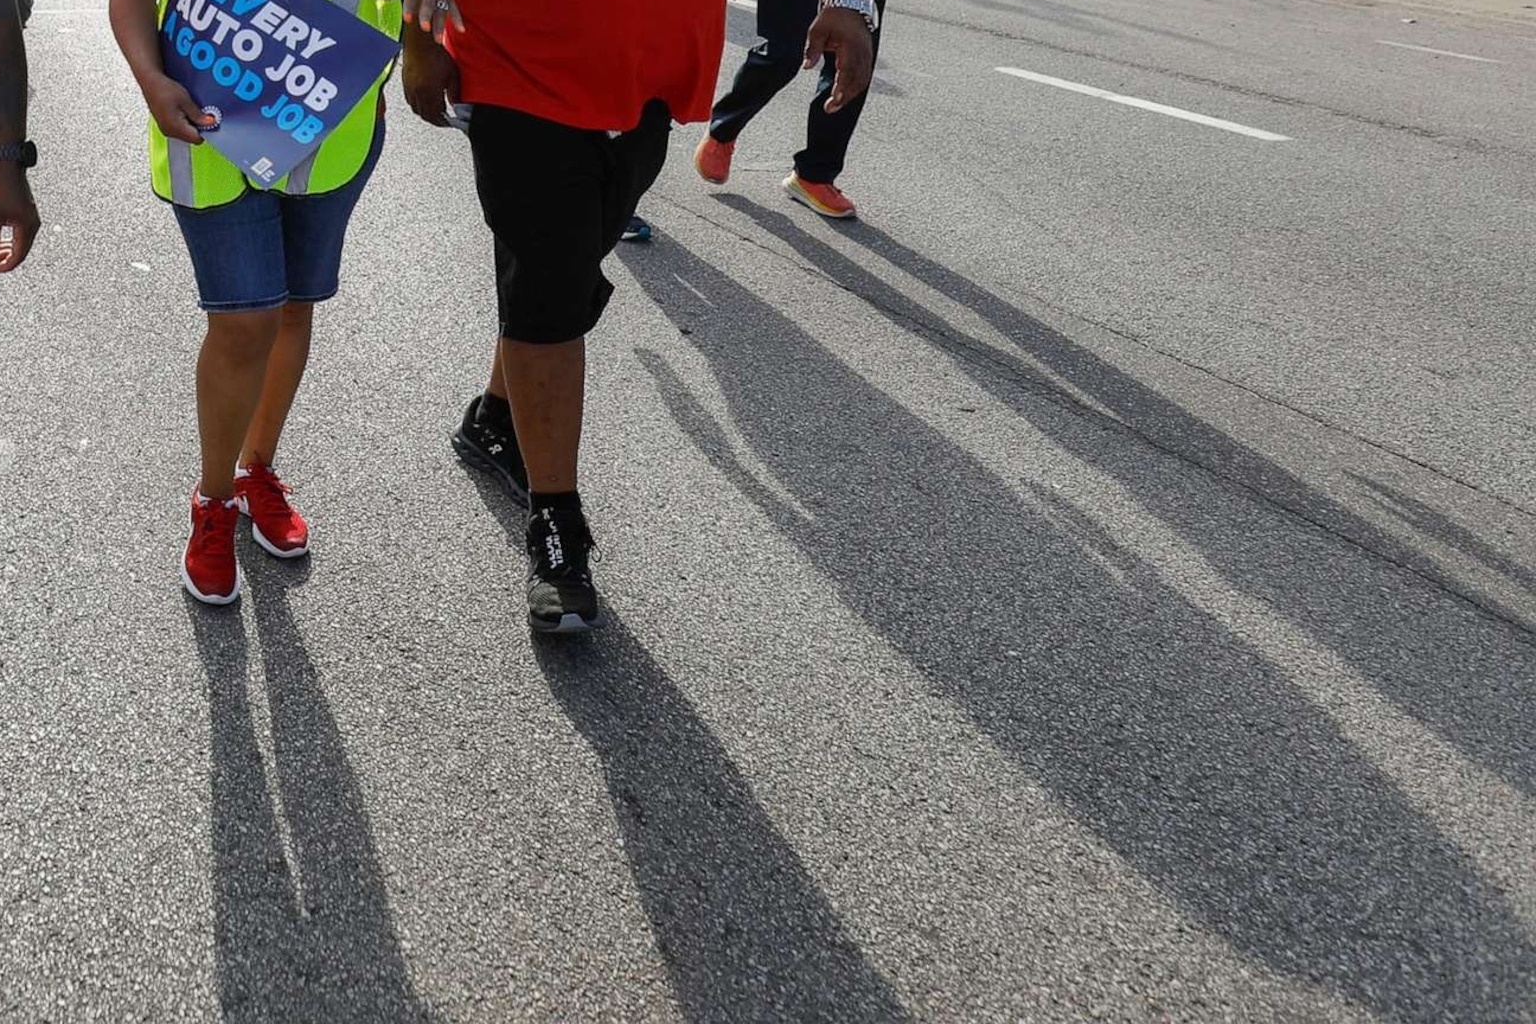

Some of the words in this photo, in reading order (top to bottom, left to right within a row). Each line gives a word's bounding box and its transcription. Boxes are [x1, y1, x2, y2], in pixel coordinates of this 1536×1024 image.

[165, 10, 177, 41] A
[176, 27, 263, 102] GOOD
[261, 94, 324, 145] JOB
[264, 54, 338, 112] JOB
